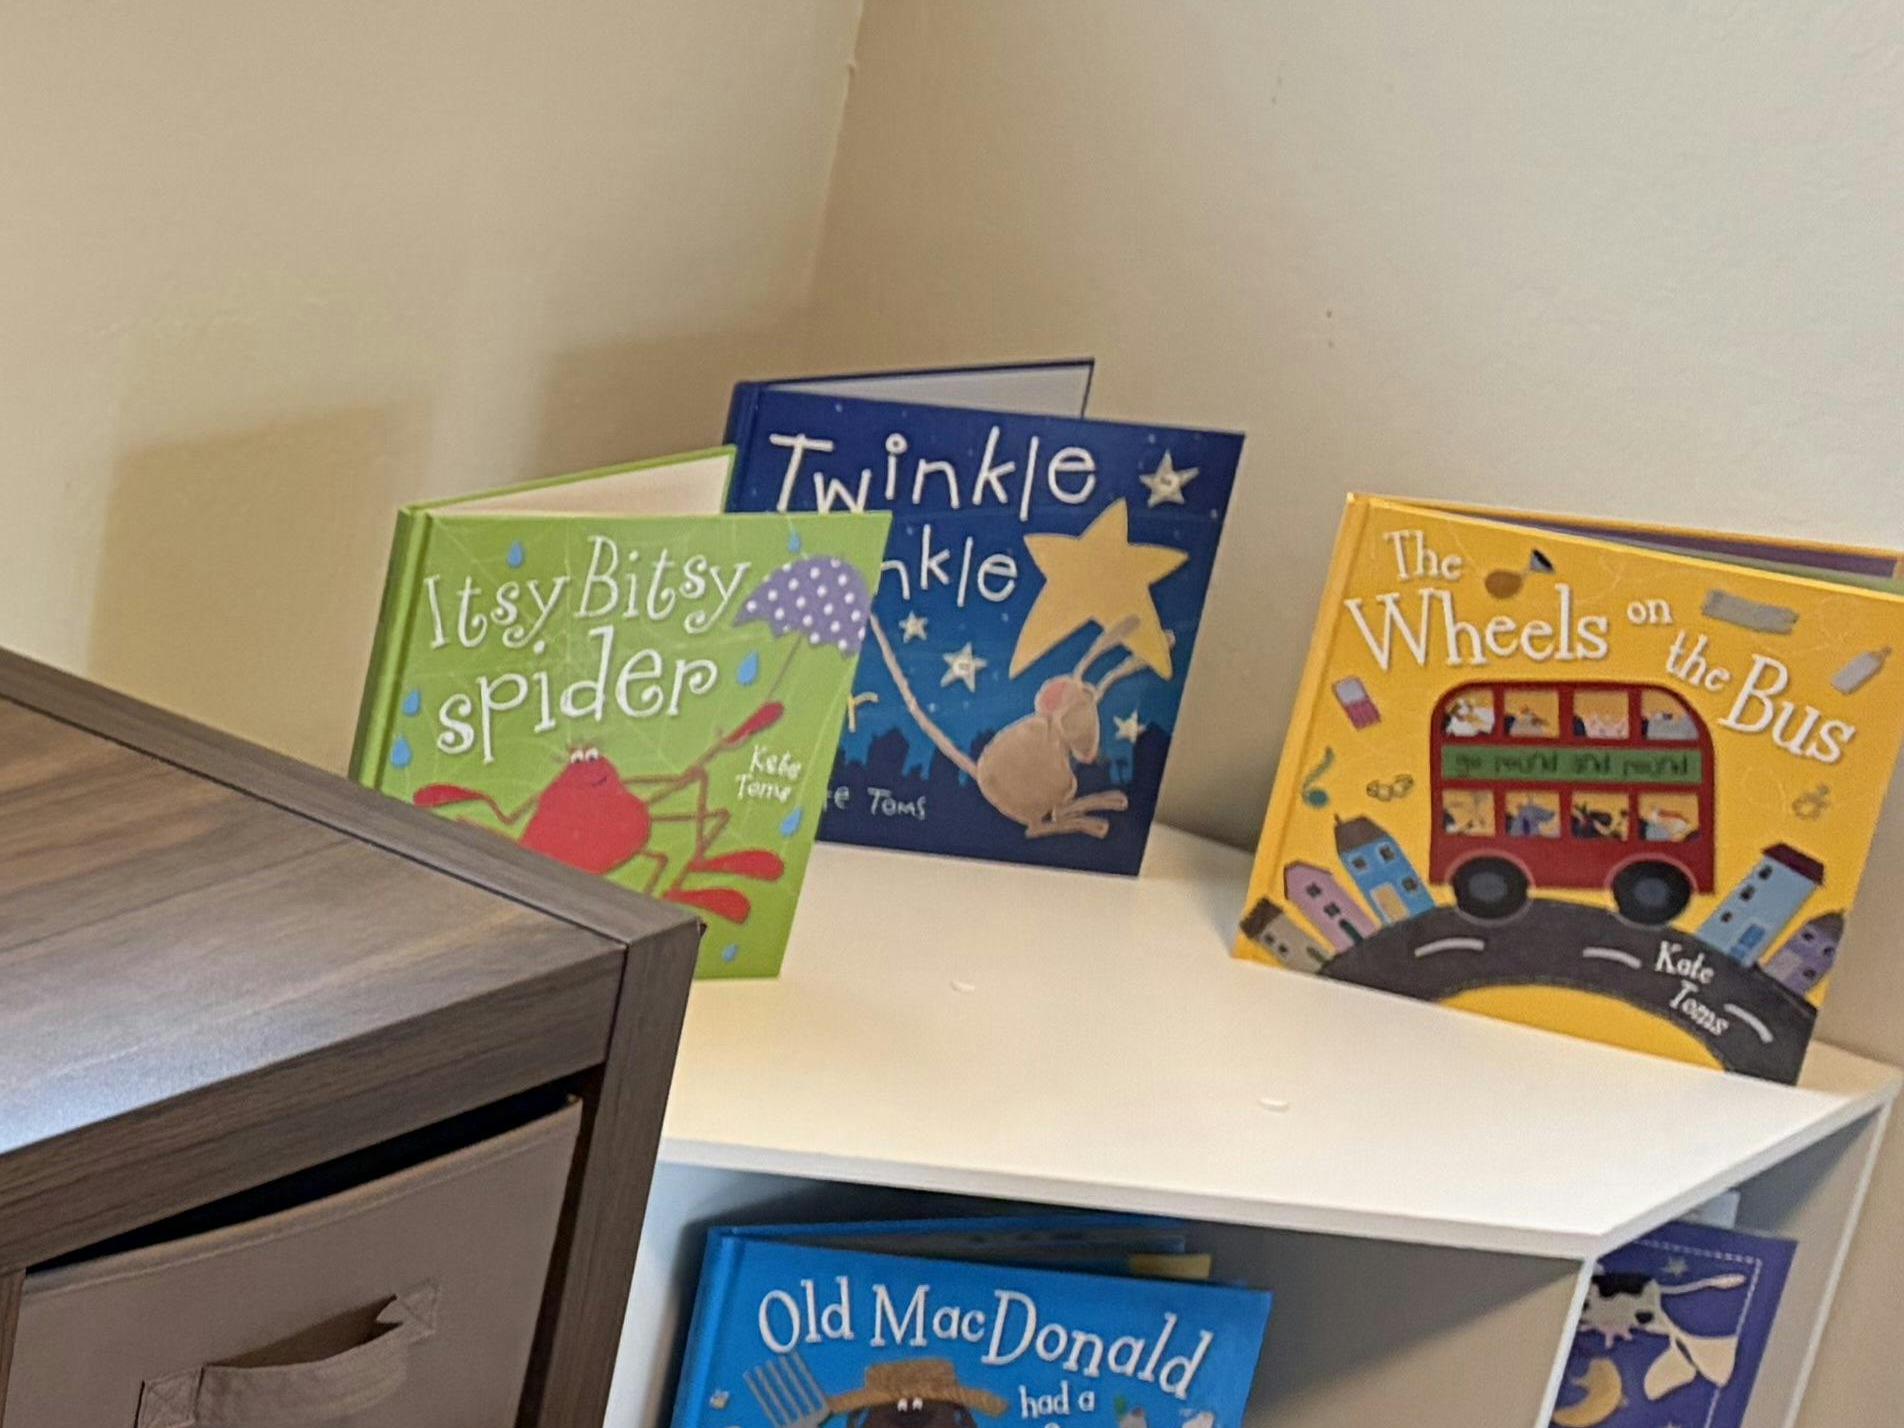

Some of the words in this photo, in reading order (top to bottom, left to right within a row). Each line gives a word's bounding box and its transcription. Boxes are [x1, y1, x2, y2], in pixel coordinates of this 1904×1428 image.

[769, 425, 1096, 522] Twinkle
[422, 573, 569, 650] Itsy
[577, 535, 751, 634] Bitsy
[879, 524, 1019, 607] nkle
[1382, 529, 1463, 582] The
[1345, 585, 1610, 671] Wheels
[1627, 597, 1673, 626] on
[435, 625, 719, 764] spider
[1663, 631, 1733, 693] the
[1718, 653, 1857, 766] Bus
[866, 786, 927, 821] Toms
[1655, 939, 1716, 984] Kate
[1667, 979, 1729, 1037] Toms
[758, 1276, 854, 1354] Old
[870, 1283, 1213, 1400] MacDonald
[1018, 1383, 1069, 1420] had
[1079, 1390, 1094, 1414] a
